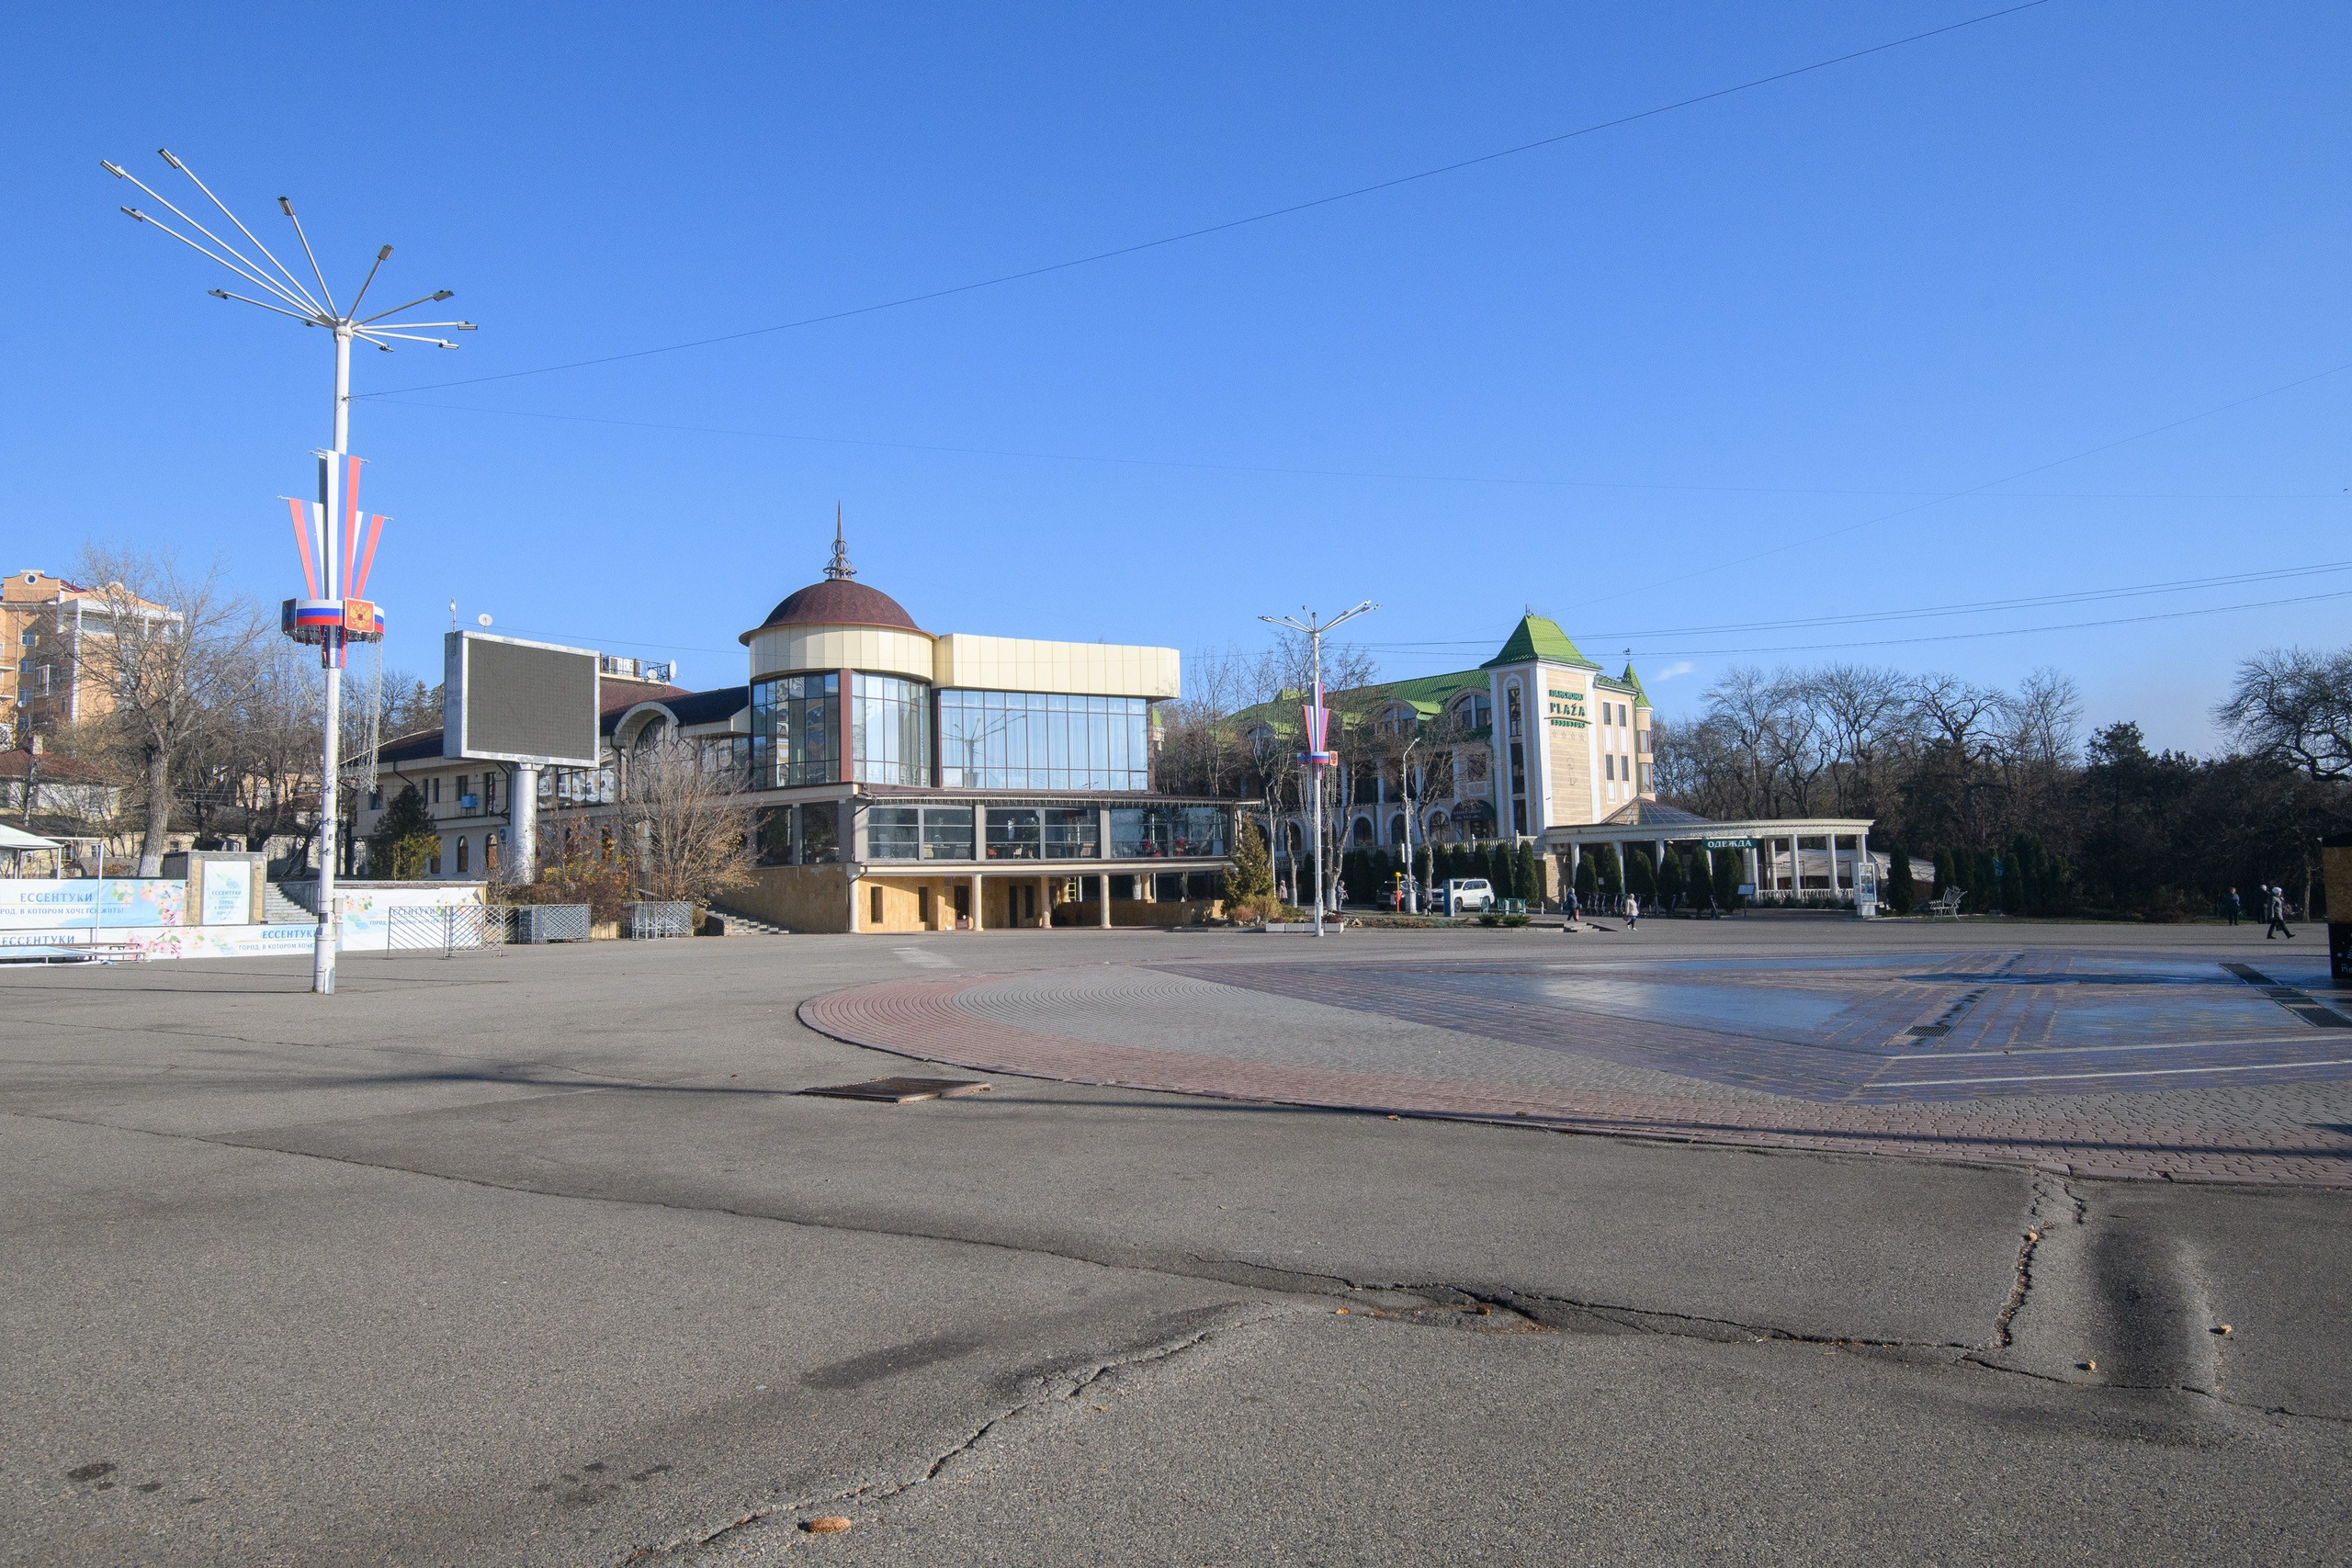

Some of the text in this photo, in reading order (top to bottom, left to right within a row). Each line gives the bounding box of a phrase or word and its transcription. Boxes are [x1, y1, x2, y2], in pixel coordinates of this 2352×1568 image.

[1707, 840, 1752, 849] ОДЕЖДА
[20, 893, 93, 903] ЕССЕНТУКИ
[0, 908, 17, 916] РОД,
[101, 907, 124, 915] ЖИТЬ!
[389, 908, 435, 916] ССЕНТУКИ
[2, 935, 74, 946] ЕССЕНТУКИ
